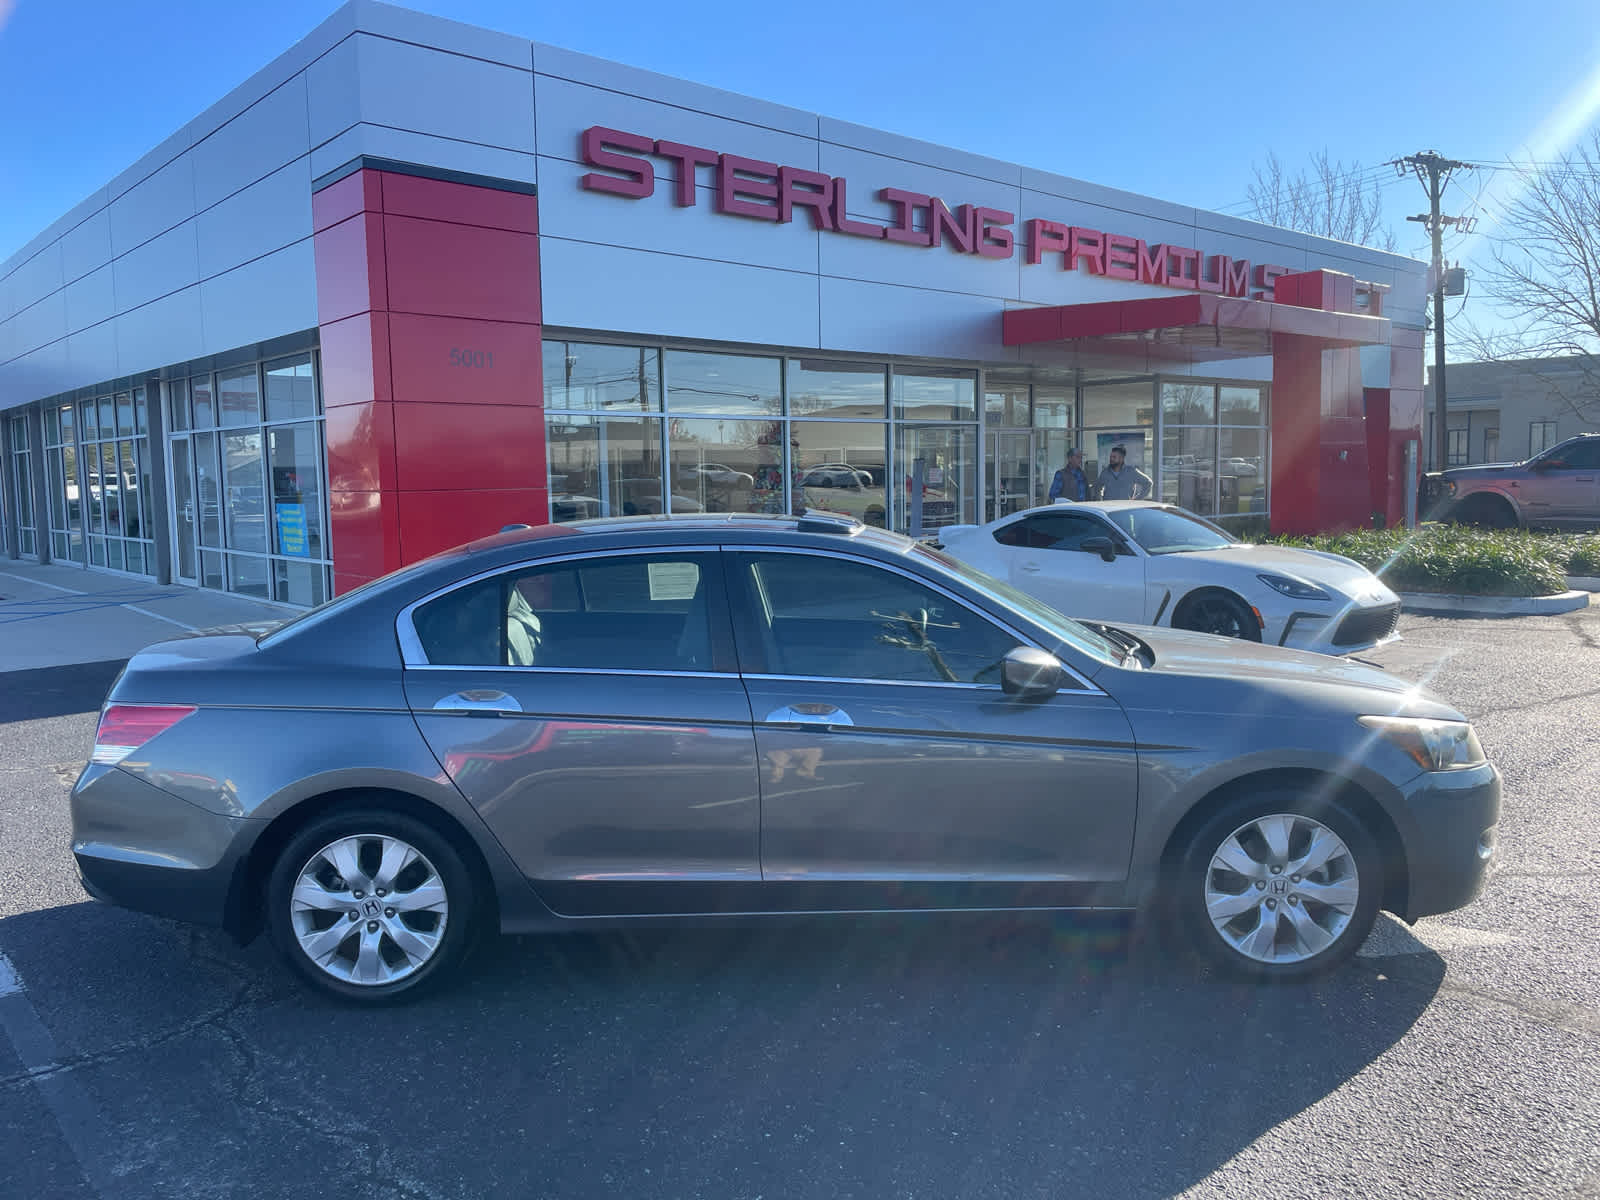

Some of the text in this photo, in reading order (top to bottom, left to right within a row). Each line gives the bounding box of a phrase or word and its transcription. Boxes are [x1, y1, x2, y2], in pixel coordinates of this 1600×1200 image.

[582, 125, 1014, 258] STERLING
[1026, 218, 1250, 297] PREMIUM
[449, 347, 494, 368] 5001
